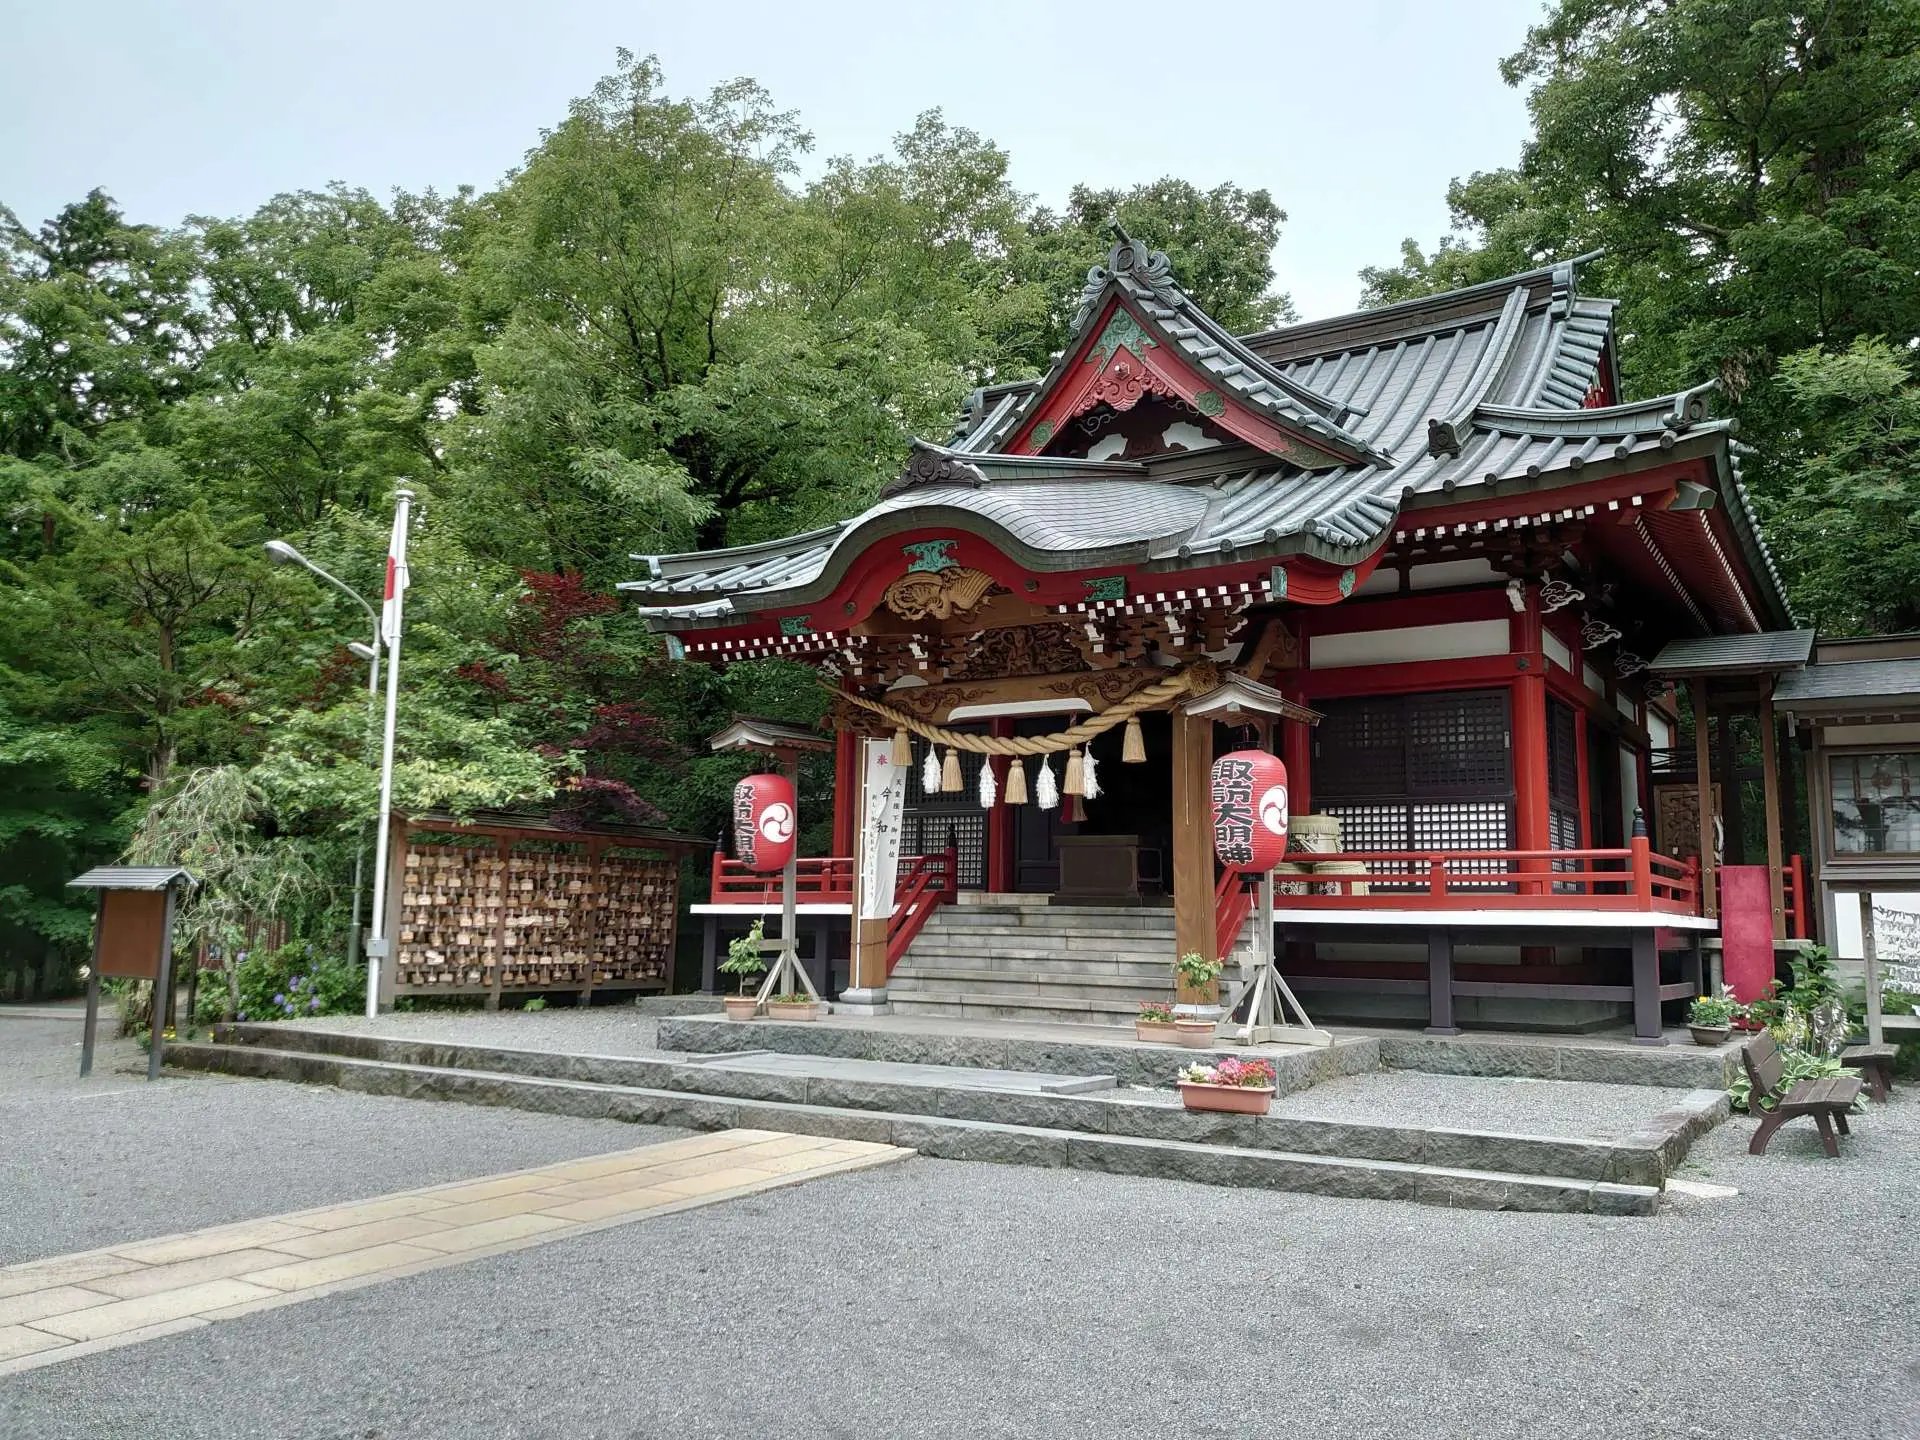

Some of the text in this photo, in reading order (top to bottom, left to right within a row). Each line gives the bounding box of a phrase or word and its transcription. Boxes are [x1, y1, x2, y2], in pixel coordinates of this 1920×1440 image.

[876, 786, 892, 833] 令和
[1212, 759, 1255, 864] 諏訪大明神
